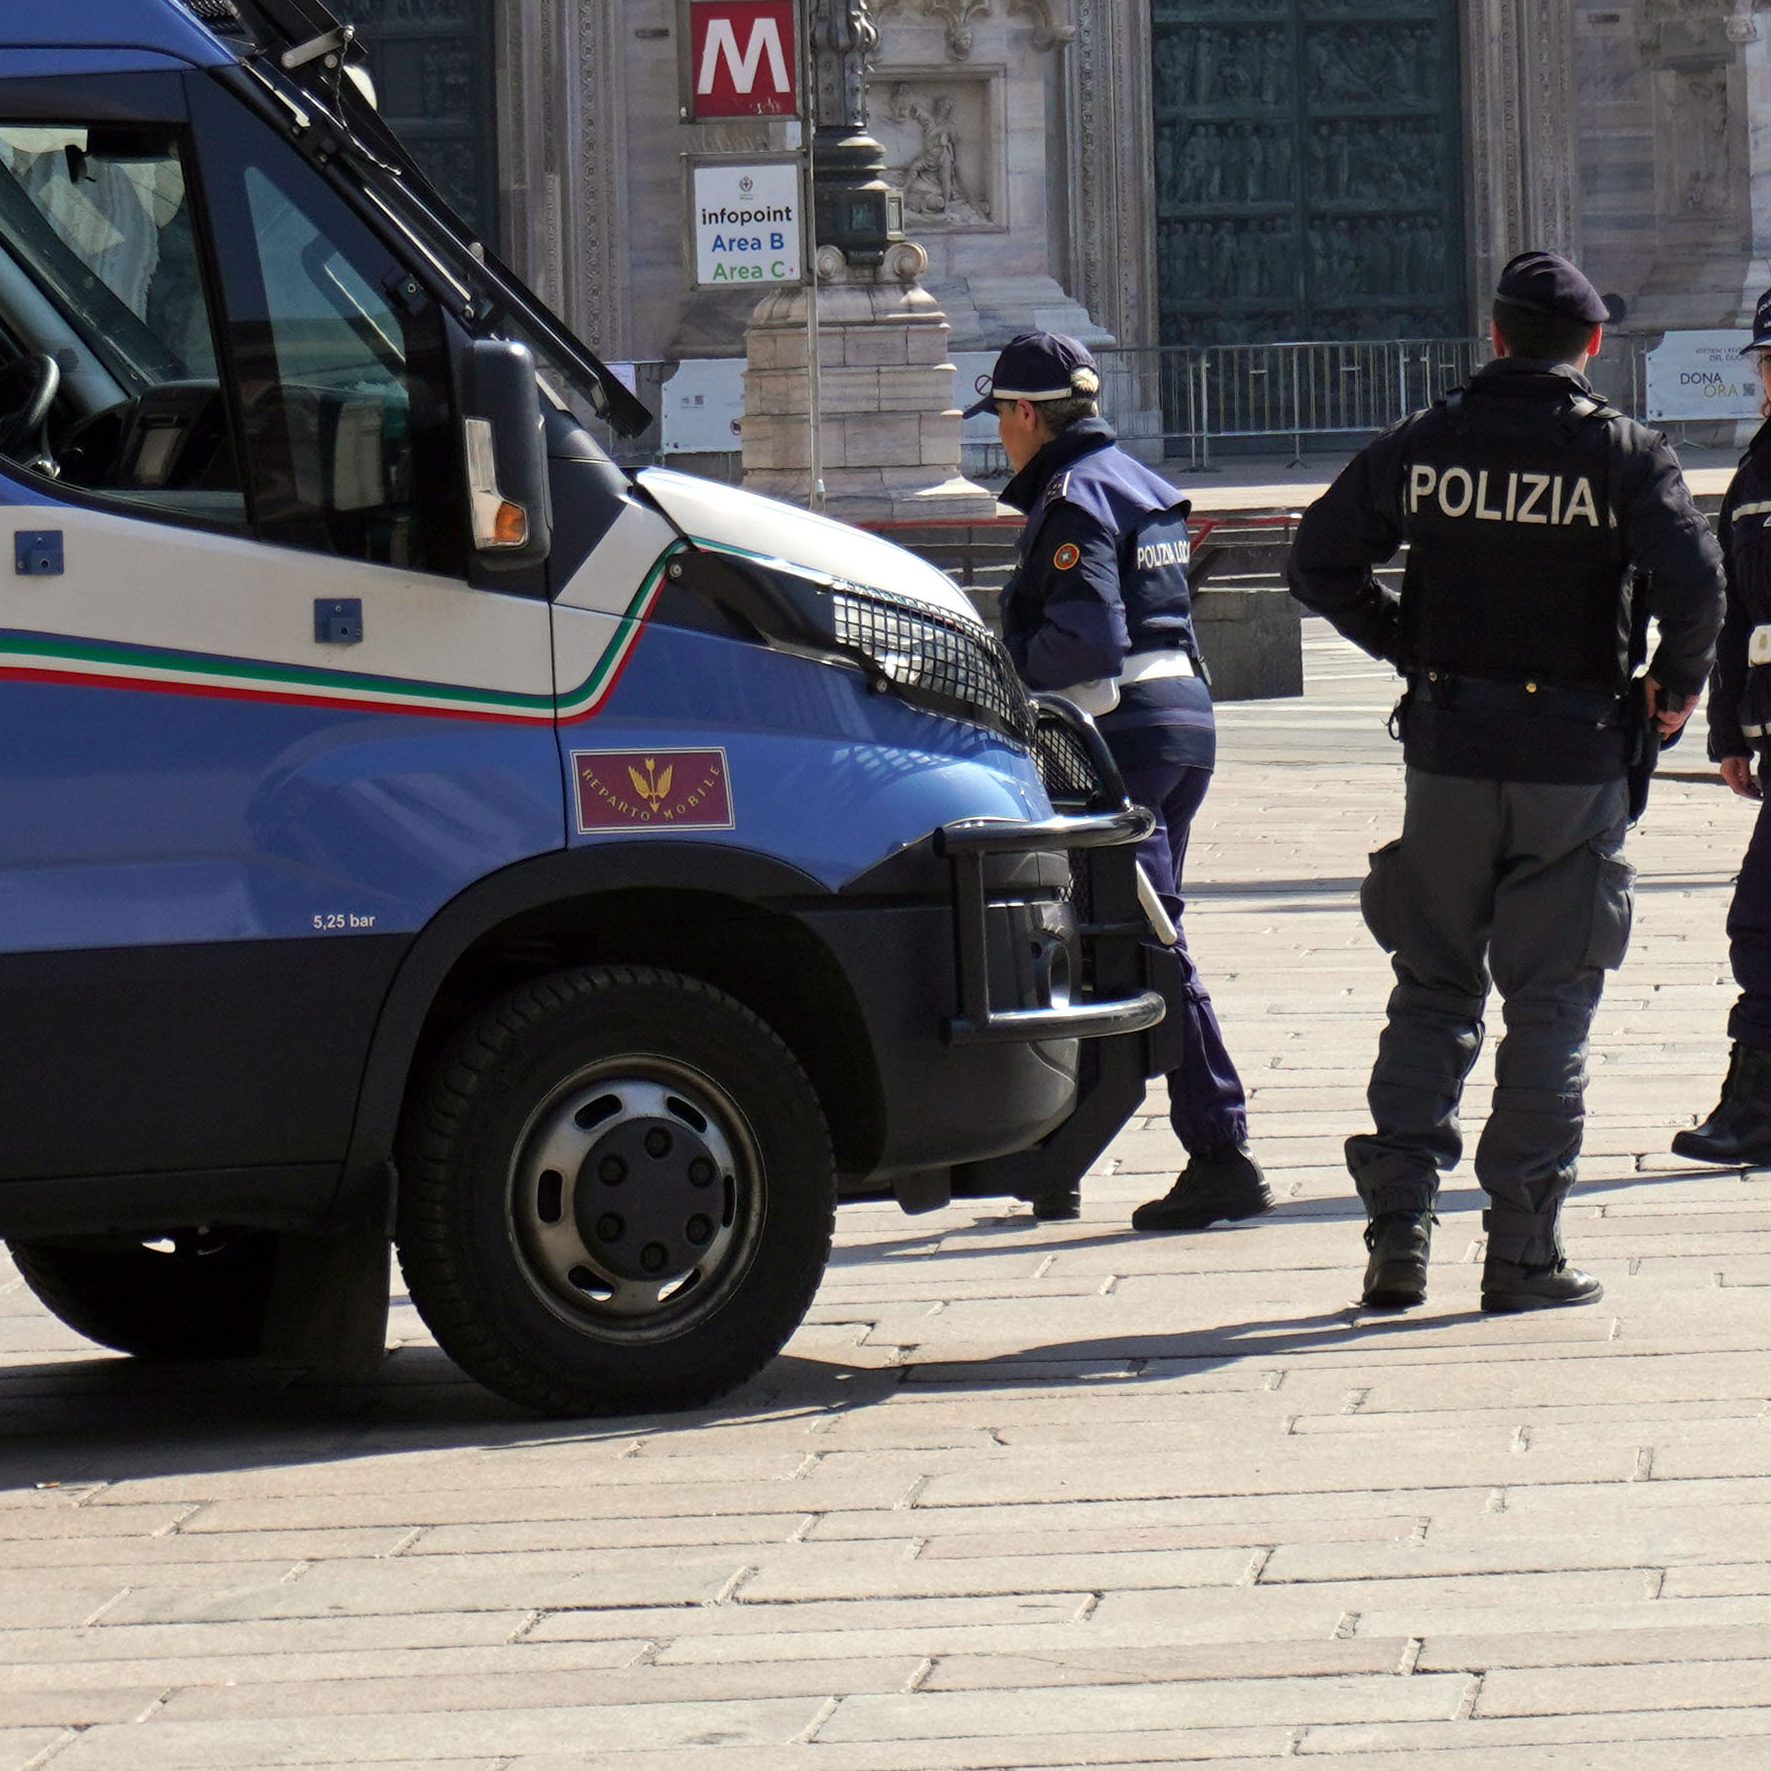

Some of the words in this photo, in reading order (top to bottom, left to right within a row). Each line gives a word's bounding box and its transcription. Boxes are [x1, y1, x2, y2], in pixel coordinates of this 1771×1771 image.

[697, 17, 791, 96] M
[701, 206, 793, 227] infopoint
[711, 234, 763, 253] Area
[770, 232, 785, 250] B
[712, 262, 764, 281] Area
[771, 260, 786, 278] C
[1680, 372, 1722, 385] DONA
[1703, 384, 1739, 398] ORA
[1410, 464, 1599, 527] POLIZIA
[1137, 542, 1175, 570] POLIZIA
[581, 768, 651, 821] REPARTO
[662, 765, 721, 821] MOBILE
[313, 914, 346, 931] 5,25
[350, 913, 376, 927] bar
